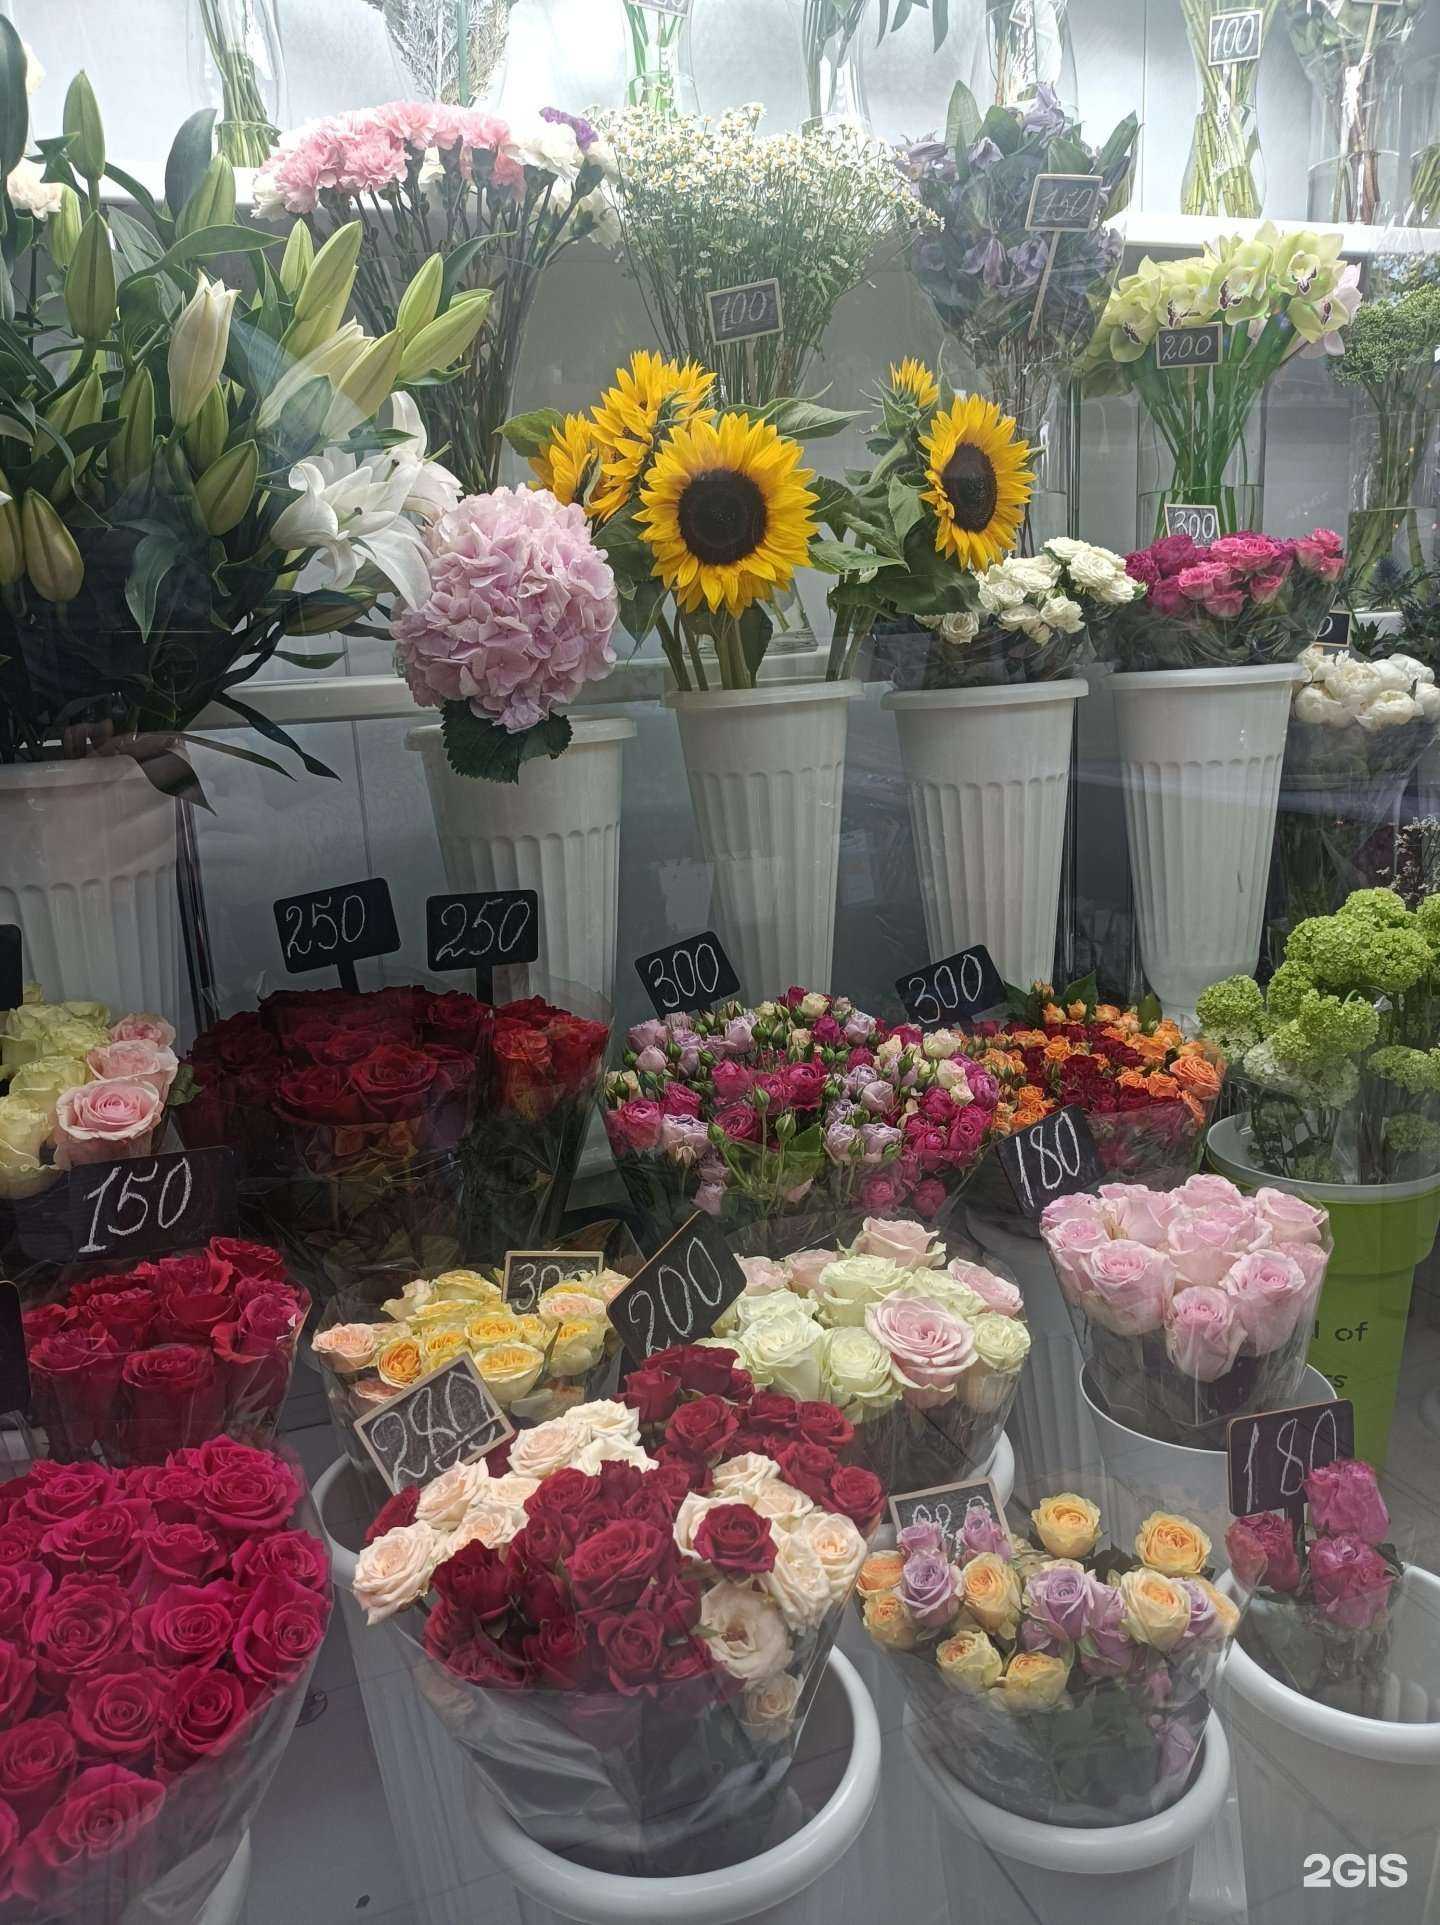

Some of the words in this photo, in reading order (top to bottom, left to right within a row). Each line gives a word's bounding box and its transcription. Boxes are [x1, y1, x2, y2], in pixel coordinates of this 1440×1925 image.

[1212, 16, 1255, 60] 100
[1040, 188, 1094, 222] 150
[720, 290, 767, 332] 100
[1162, 335, 1212, 361] 200
[1174, 511, 1215, 540] 300
[285, 895, 366, 959] 250
[436, 898, 531, 962] 250
[648, 943, 720, 1008] 300
[908, 954, 983, 1024] 300
[1015, 1111, 1080, 1208] 180
[78, 1157, 193, 1253] 150
[628, 1236, 723, 1358] 200
[1334, 1321, 1369, 1342] of
[1243, 1408, 1338, 1513] 180
